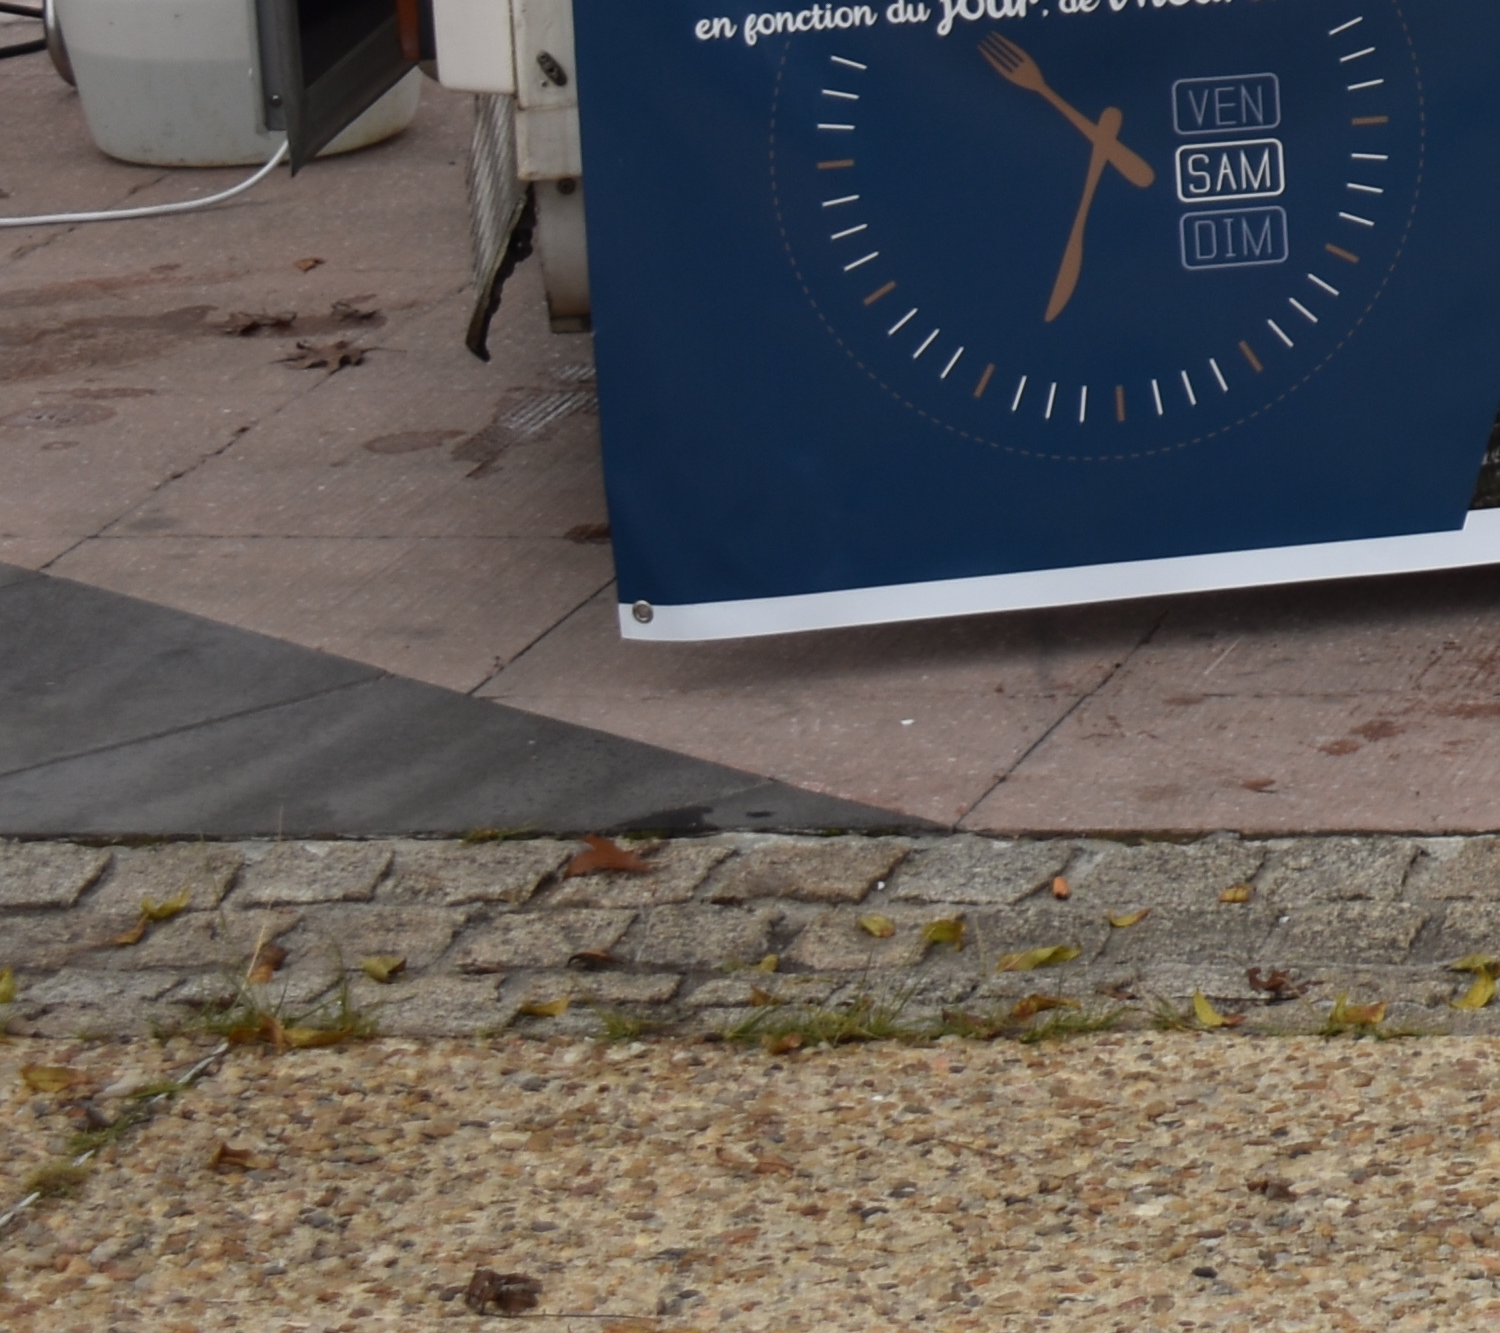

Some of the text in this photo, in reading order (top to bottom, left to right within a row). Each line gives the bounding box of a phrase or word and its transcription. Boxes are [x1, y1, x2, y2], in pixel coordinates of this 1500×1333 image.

[695, 12, 737, 40] en
[743, 1, 877, 45] fonction
[1187, 84, 1266, 127] VEN
[1186, 148, 1272, 192] SAM
[1193, 217, 1275, 260] DIM
